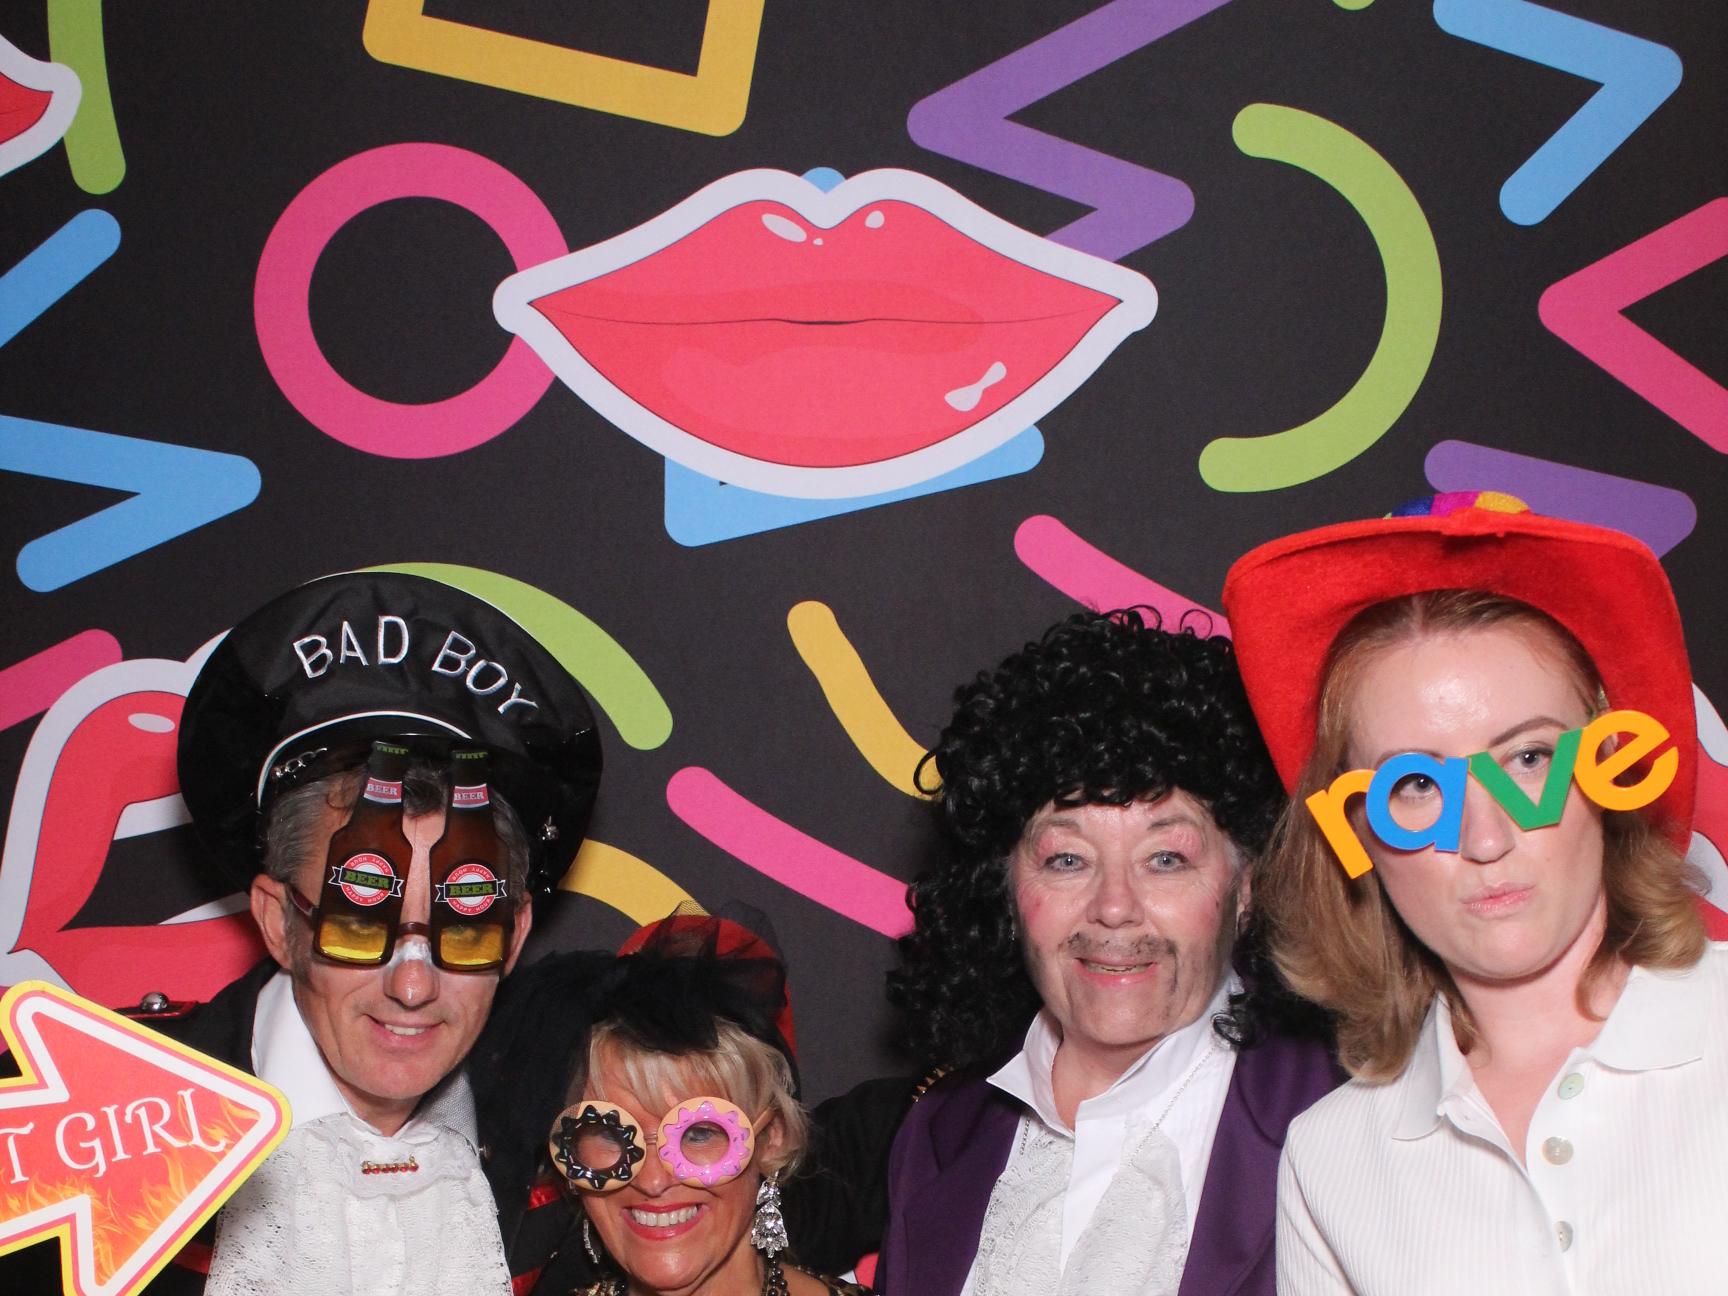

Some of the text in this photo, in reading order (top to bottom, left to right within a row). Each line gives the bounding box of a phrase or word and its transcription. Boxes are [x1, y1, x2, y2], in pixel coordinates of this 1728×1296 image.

[293, 615, 539, 714] BAD BOY
[366, 783, 398, 795] BEER
[454, 791, 485, 800] BEER
[1305, 709, 1679, 881] rave
[343, 870, 390, 889] BEER
[345, 886, 385, 903] HAPPY HOUR
[450, 883, 494, 897] BEER
[452, 898, 492, 913] HAPPY HOUR
[55, 1088, 227, 1178] GIRL
